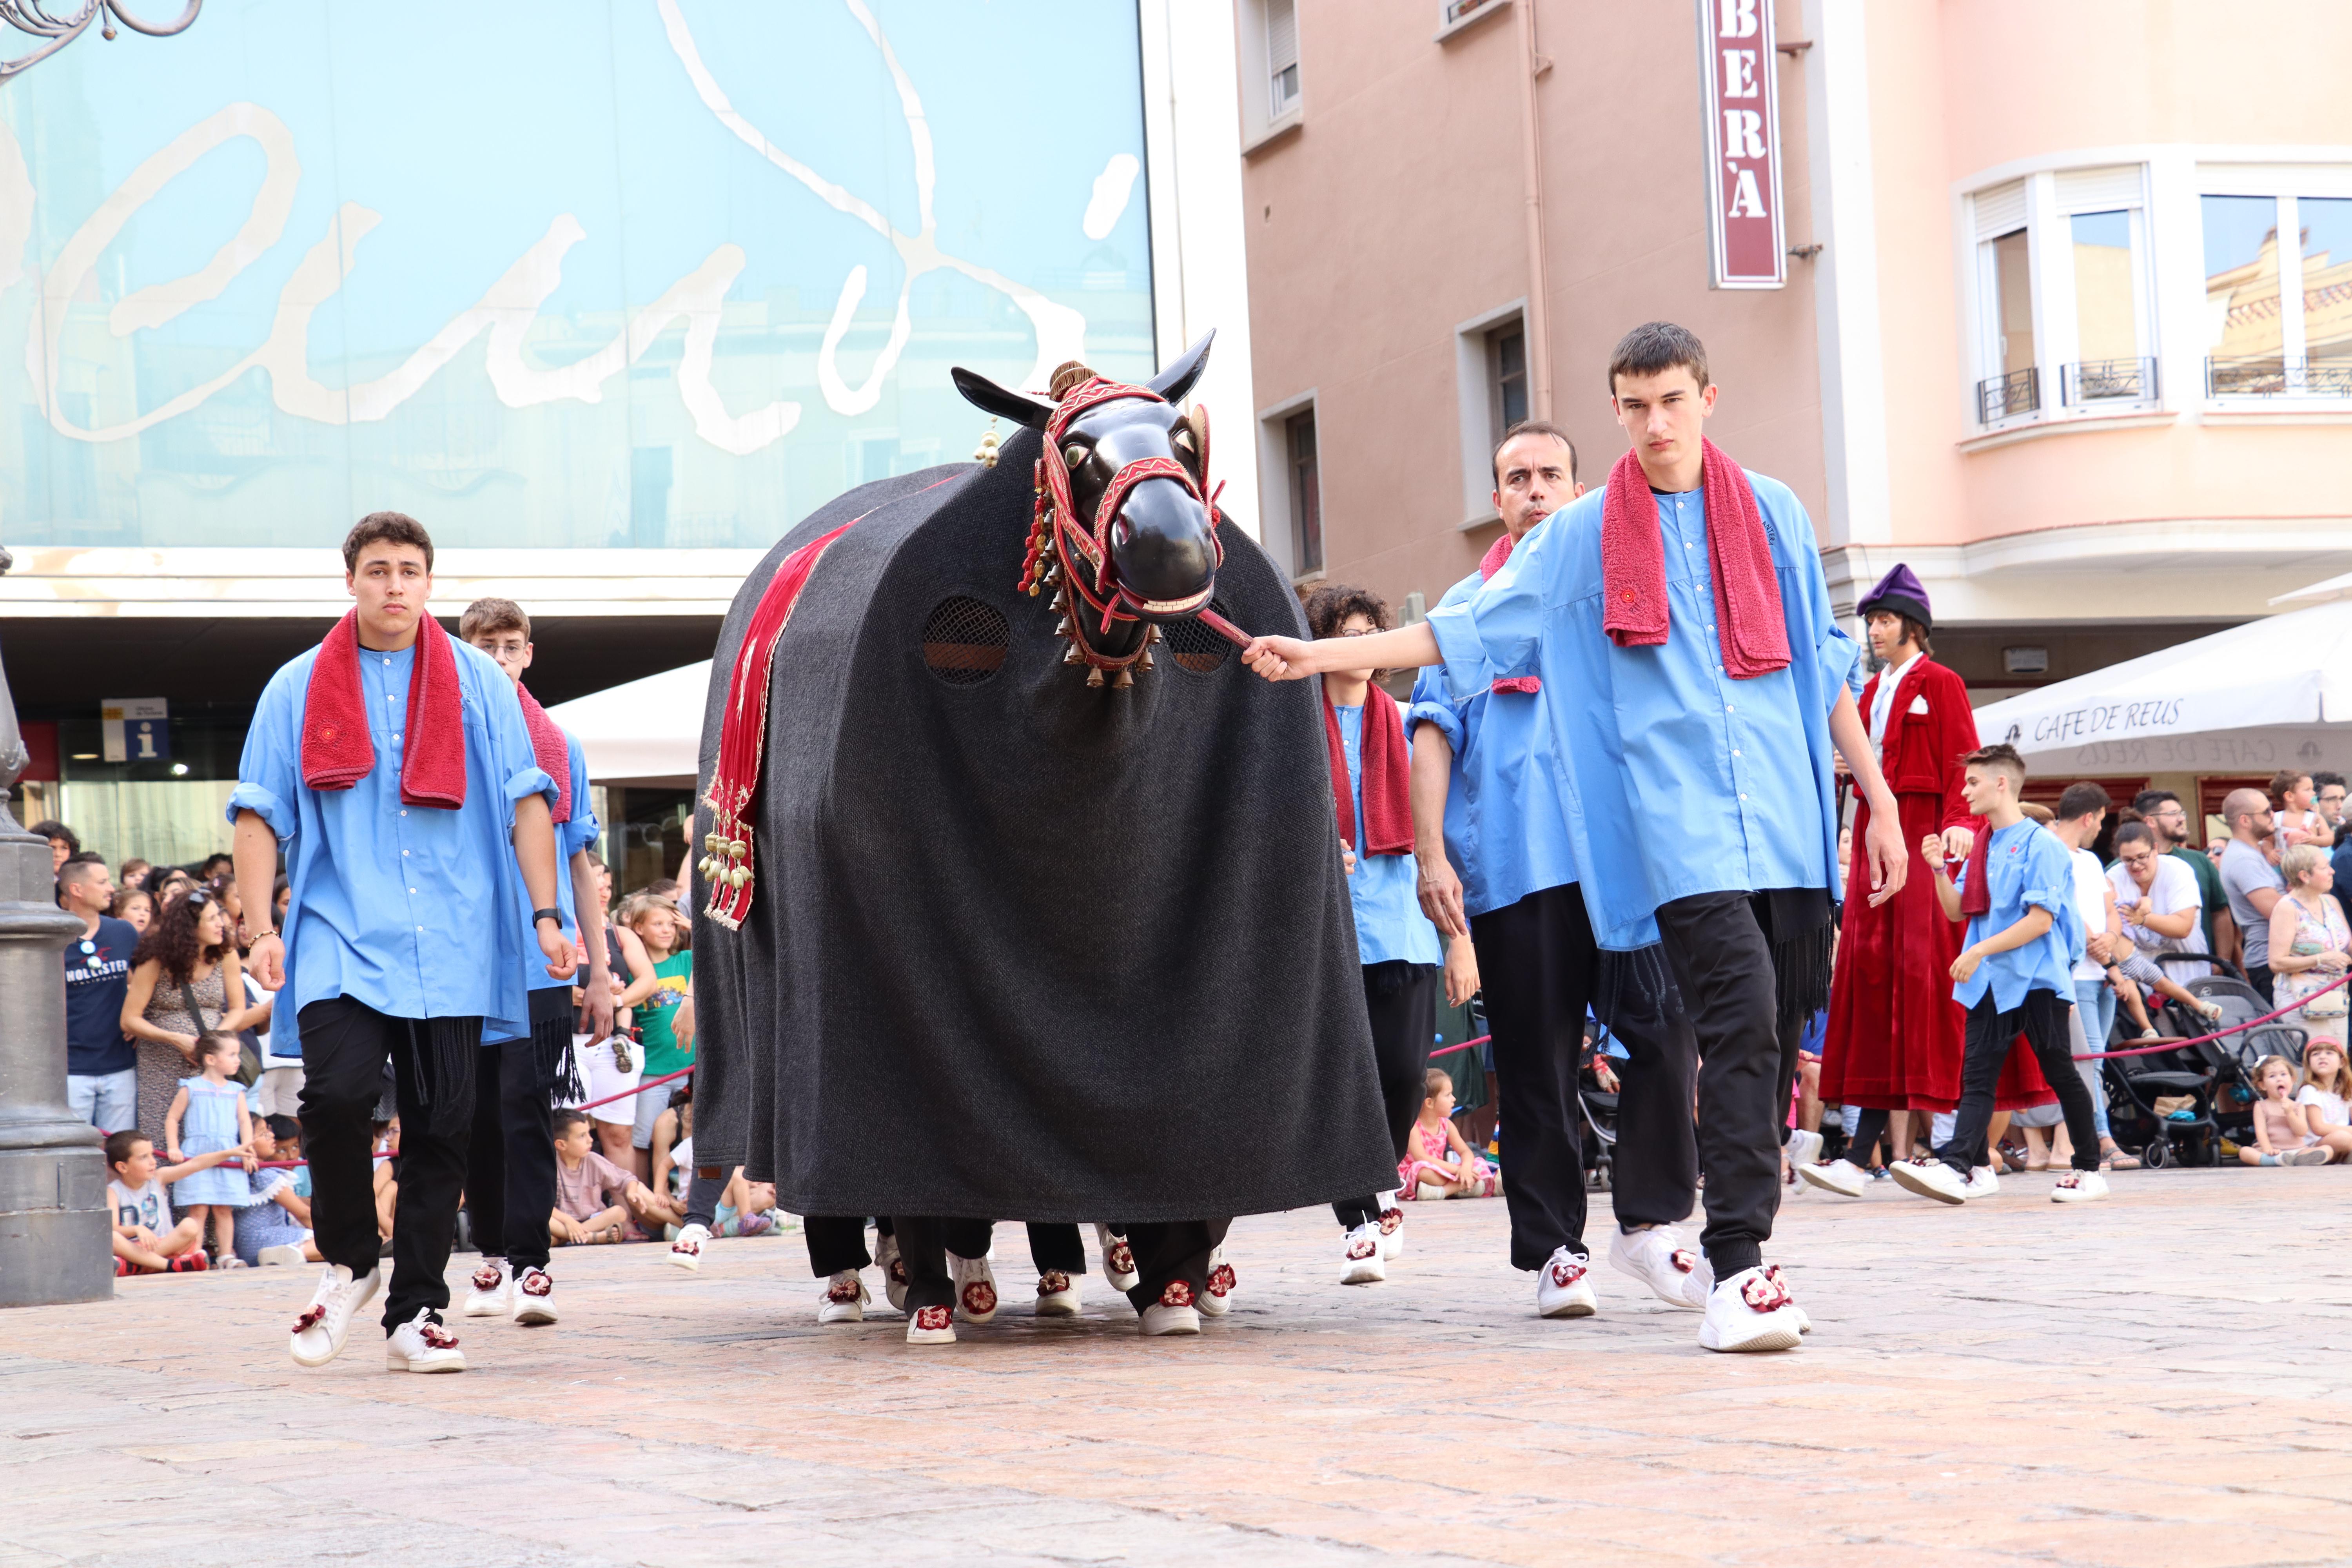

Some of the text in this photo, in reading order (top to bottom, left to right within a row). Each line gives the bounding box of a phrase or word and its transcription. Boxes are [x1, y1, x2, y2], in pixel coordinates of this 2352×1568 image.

[2034, 698, 2184, 741] CAFE DE REUS
